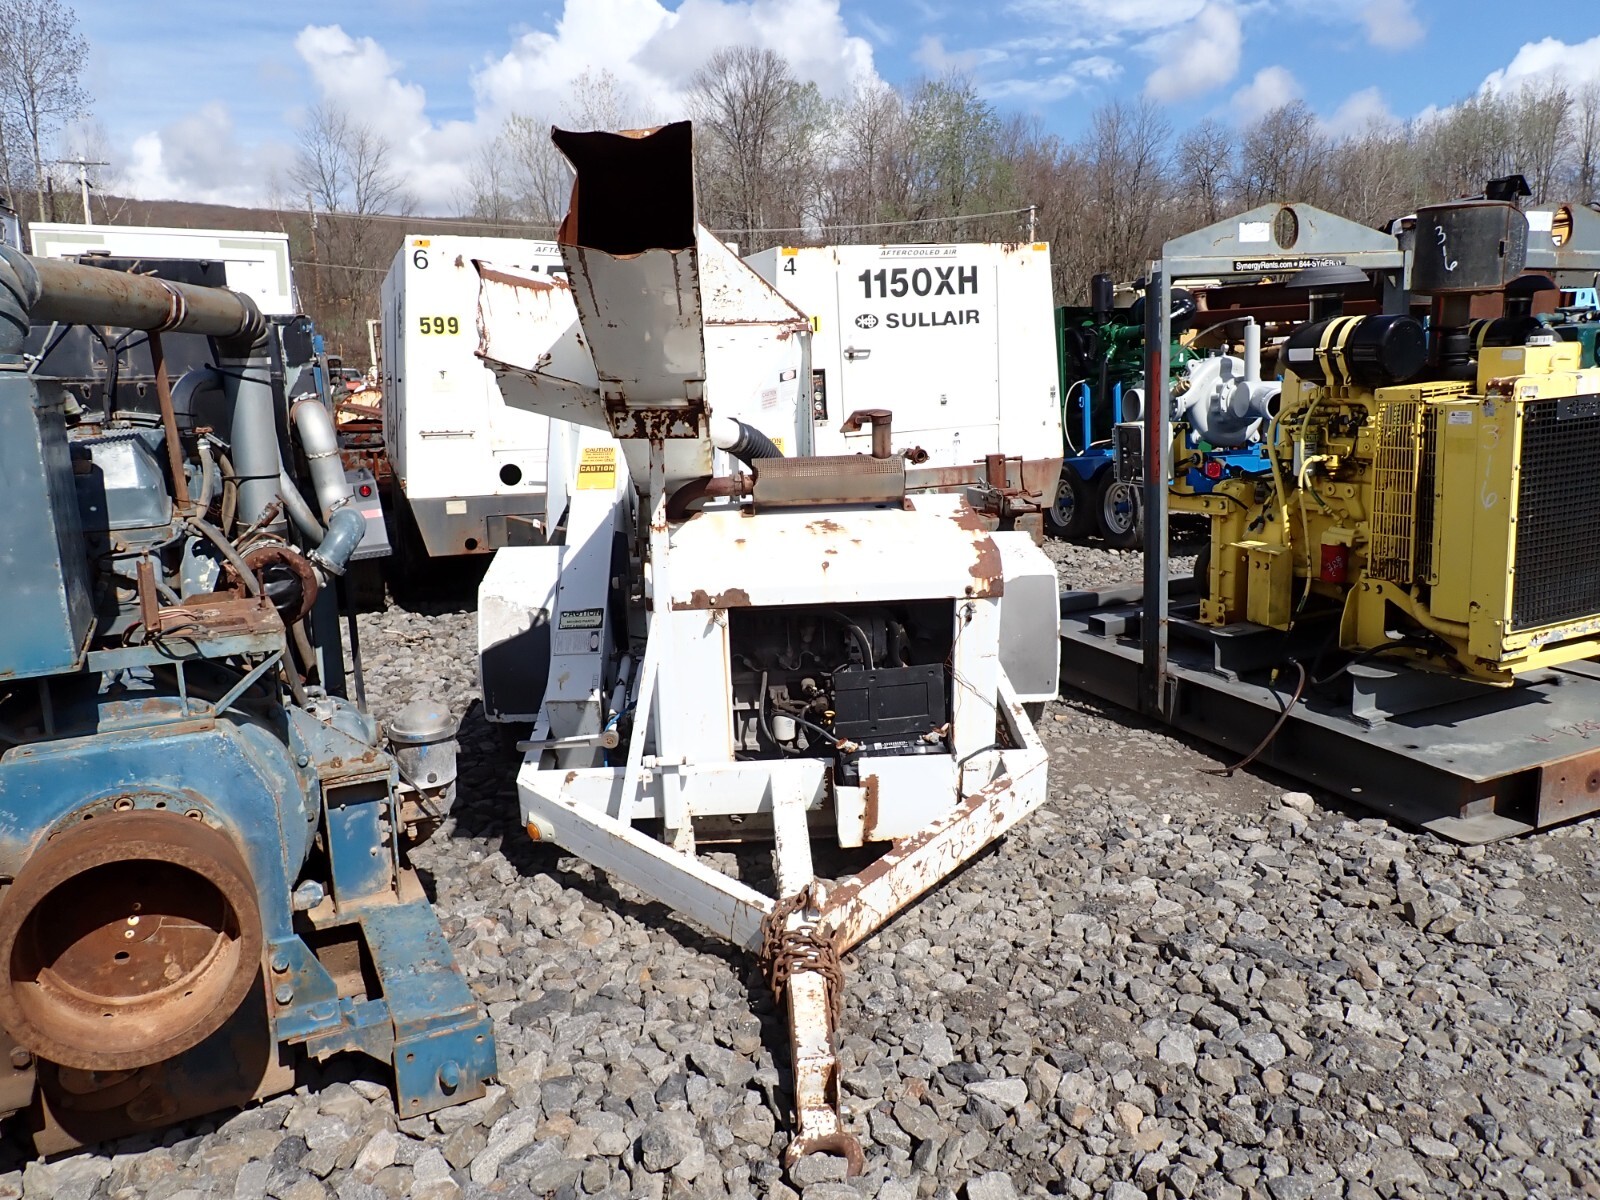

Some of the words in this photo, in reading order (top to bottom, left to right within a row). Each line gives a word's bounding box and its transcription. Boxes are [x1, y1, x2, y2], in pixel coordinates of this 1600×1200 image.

[413, 249, 429, 270] 6
[880, 248, 941, 256] AFTERCOOLED
[783, 257, 797, 275] 4
[1236, 261, 1292, 271] SynergyRents.com
[858, 265, 978, 299] 1150XH
[419, 316, 459, 335] 599
[885, 309, 980, 329] SULLAIR
